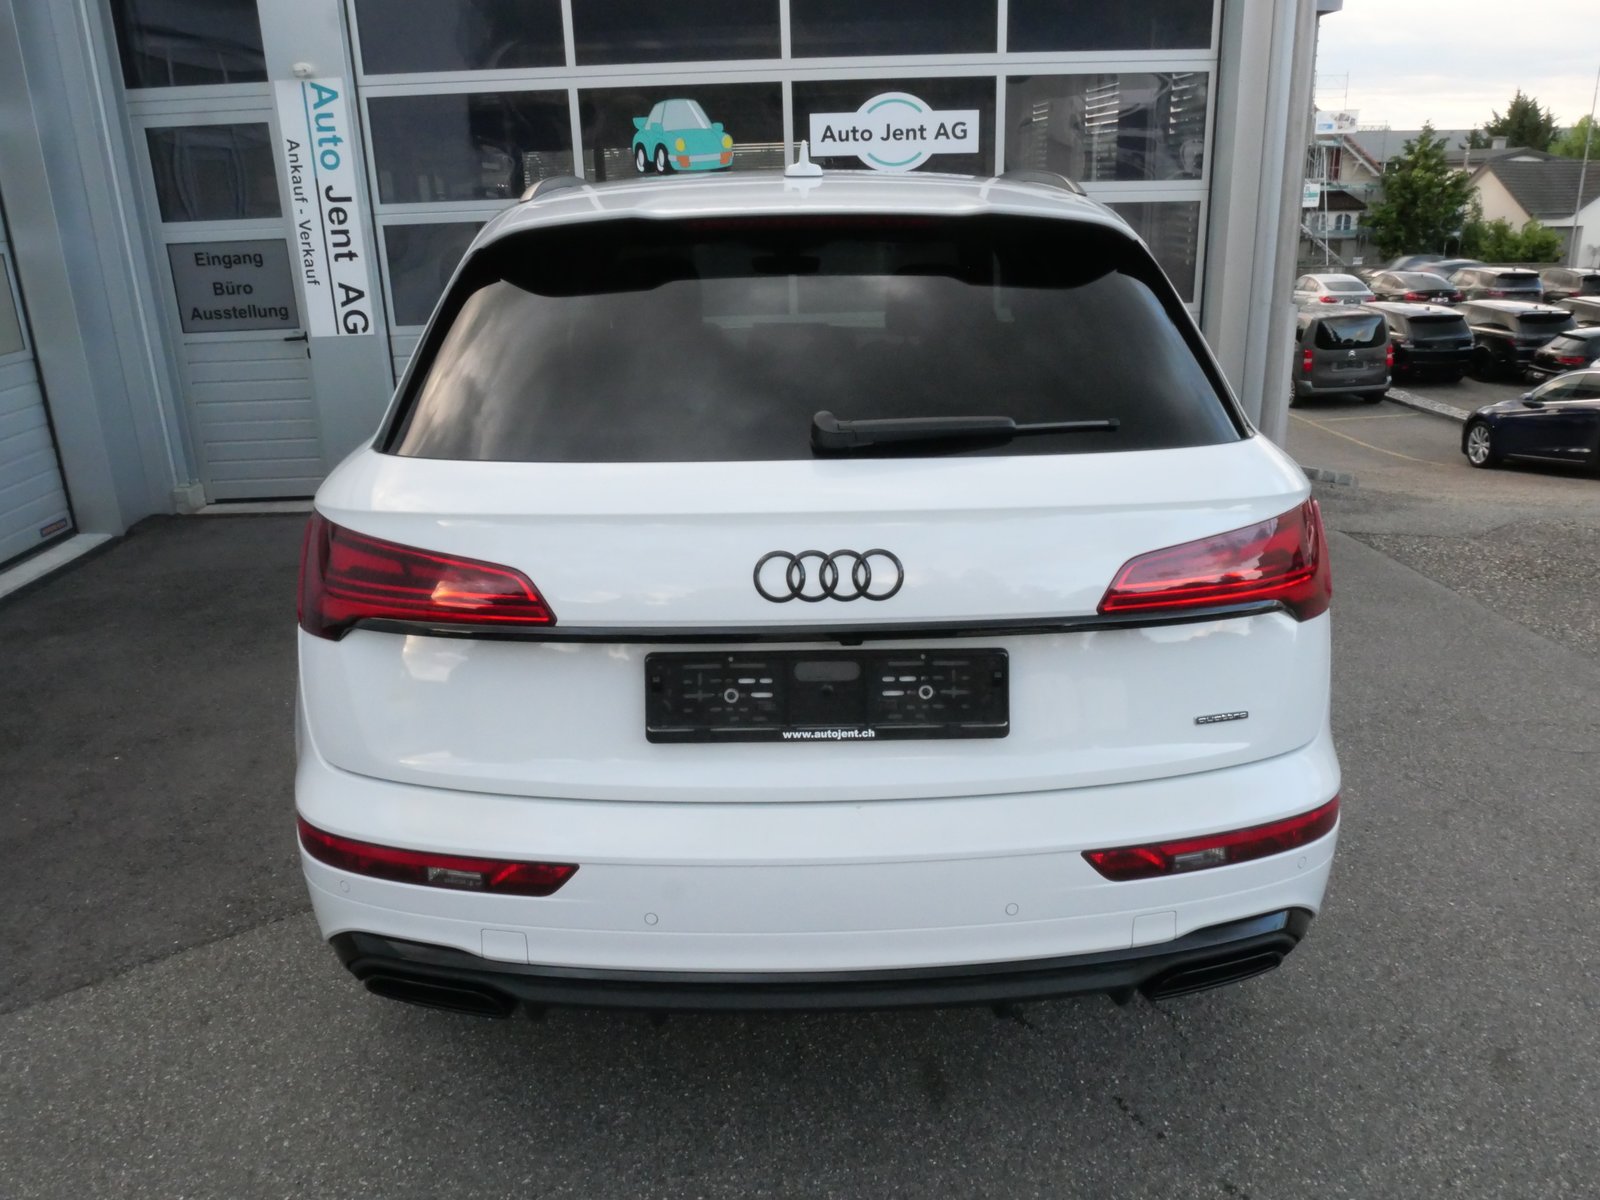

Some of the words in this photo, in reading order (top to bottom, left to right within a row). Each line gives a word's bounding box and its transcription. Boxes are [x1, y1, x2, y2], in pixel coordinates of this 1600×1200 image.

[310, 82, 343, 171] Auto
[820, 125, 873, 143] Auto
[879, 123, 927, 142] Jent
[934, 122, 968, 140] AG
[286, 139, 308, 204] Ankauf
[298, 219, 320, 286] Verkauf
[324, 185, 359, 262] Jent
[194, 252, 264, 268] Eingang
[212, 281, 254, 296] Büro
[190, 304, 289, 321] Ausstellung
[338, 281, 370, 335] AG
[782, 729, 875, 740] www.autojent.ch
